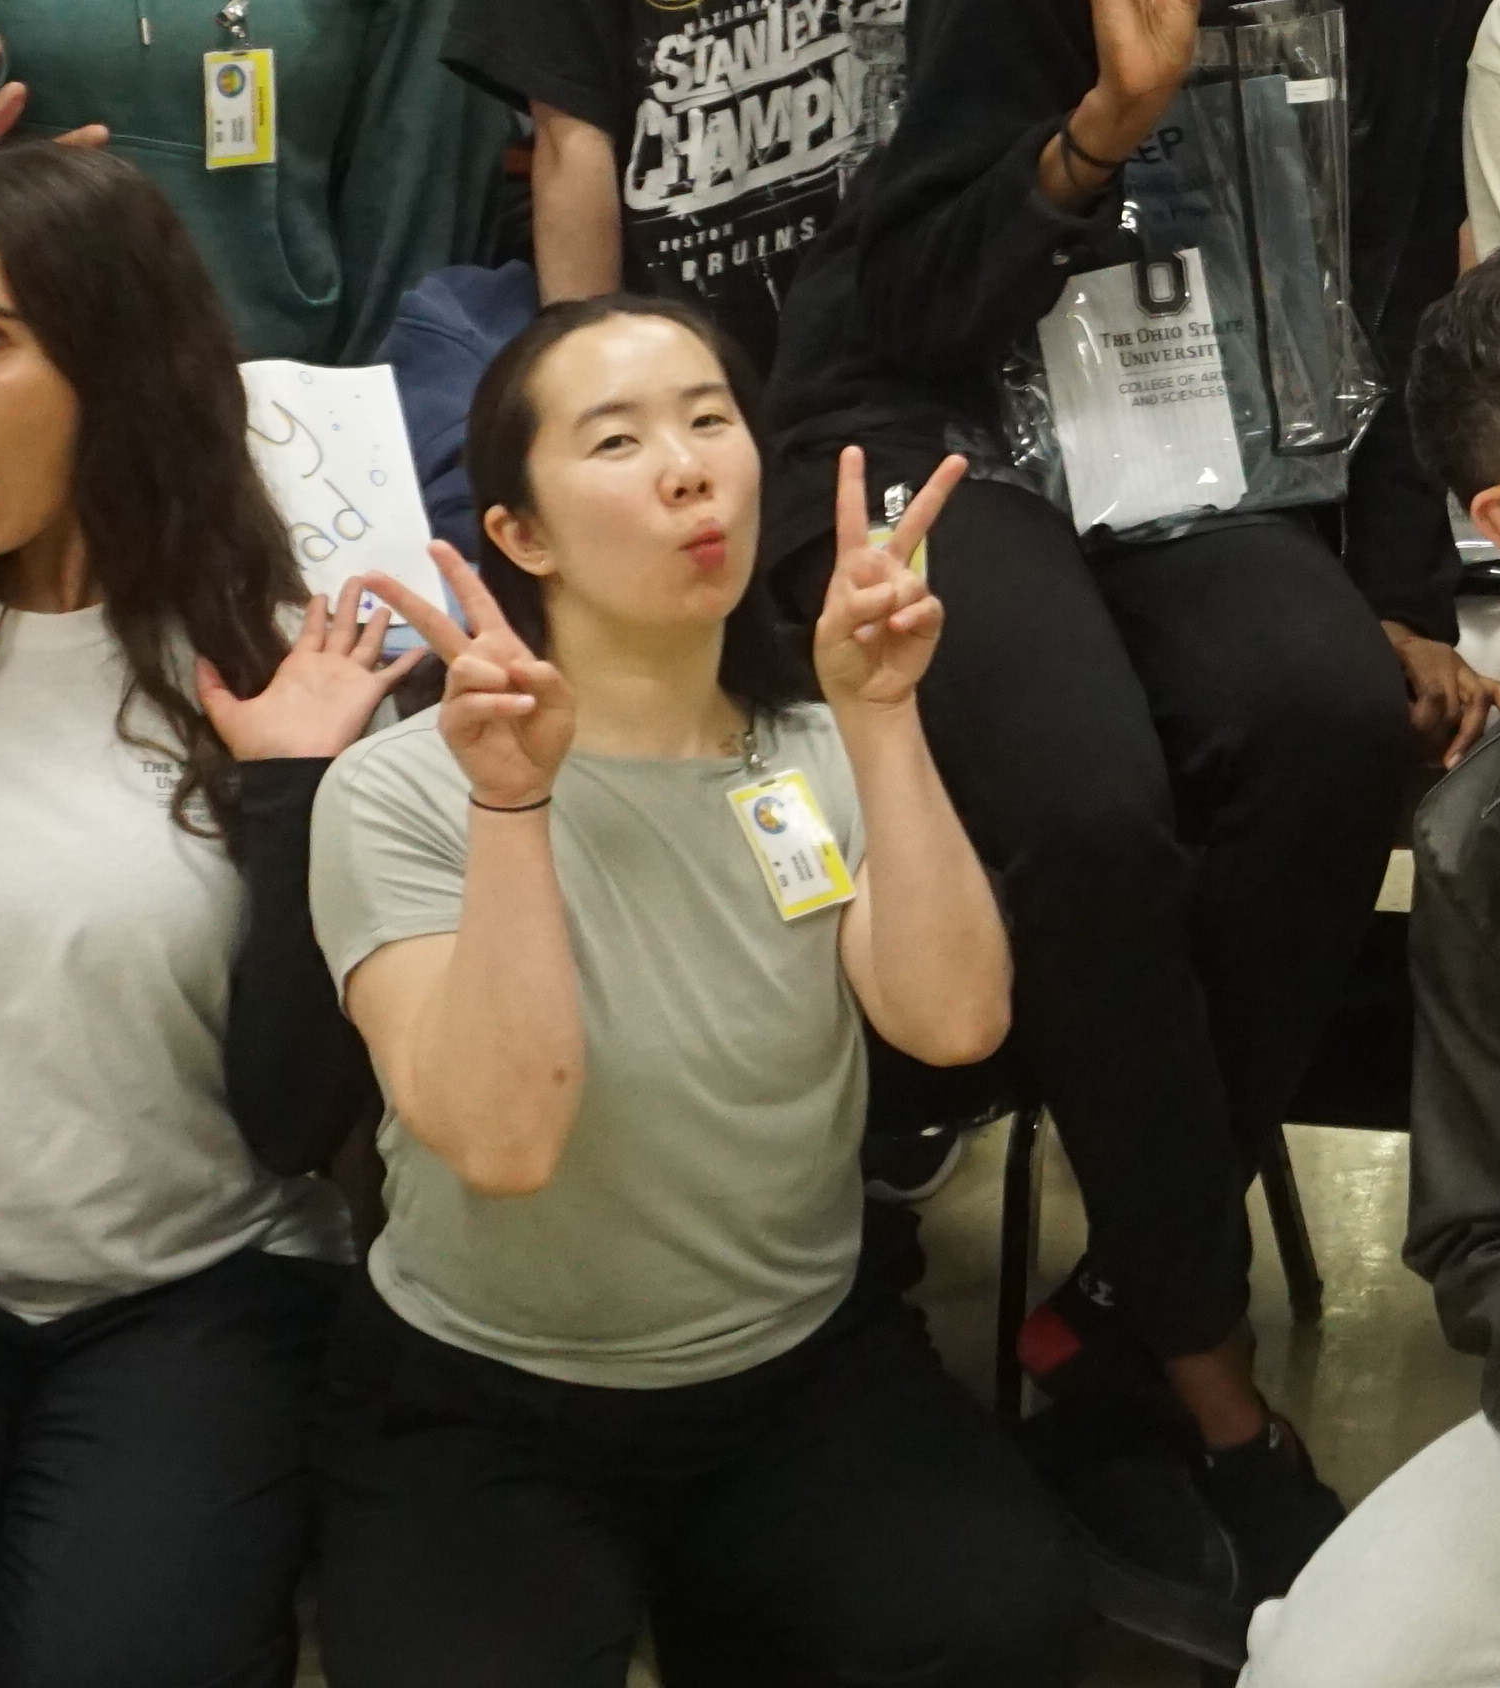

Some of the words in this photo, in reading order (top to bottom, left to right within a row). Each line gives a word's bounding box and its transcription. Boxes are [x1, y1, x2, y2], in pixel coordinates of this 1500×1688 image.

[1100, 332, 1134, 348] THE
[1137, 325, 1183, 344] OHIO
[1119, 342, 1228, 368] UNIVERSITY
[1119, 376, 1174, 395] COLLEGE
[1177, 373, 1197, 387] OF
[1131, 394, 1158, 408] AND
[1161, 385, 1225, 404] SCIENCES
